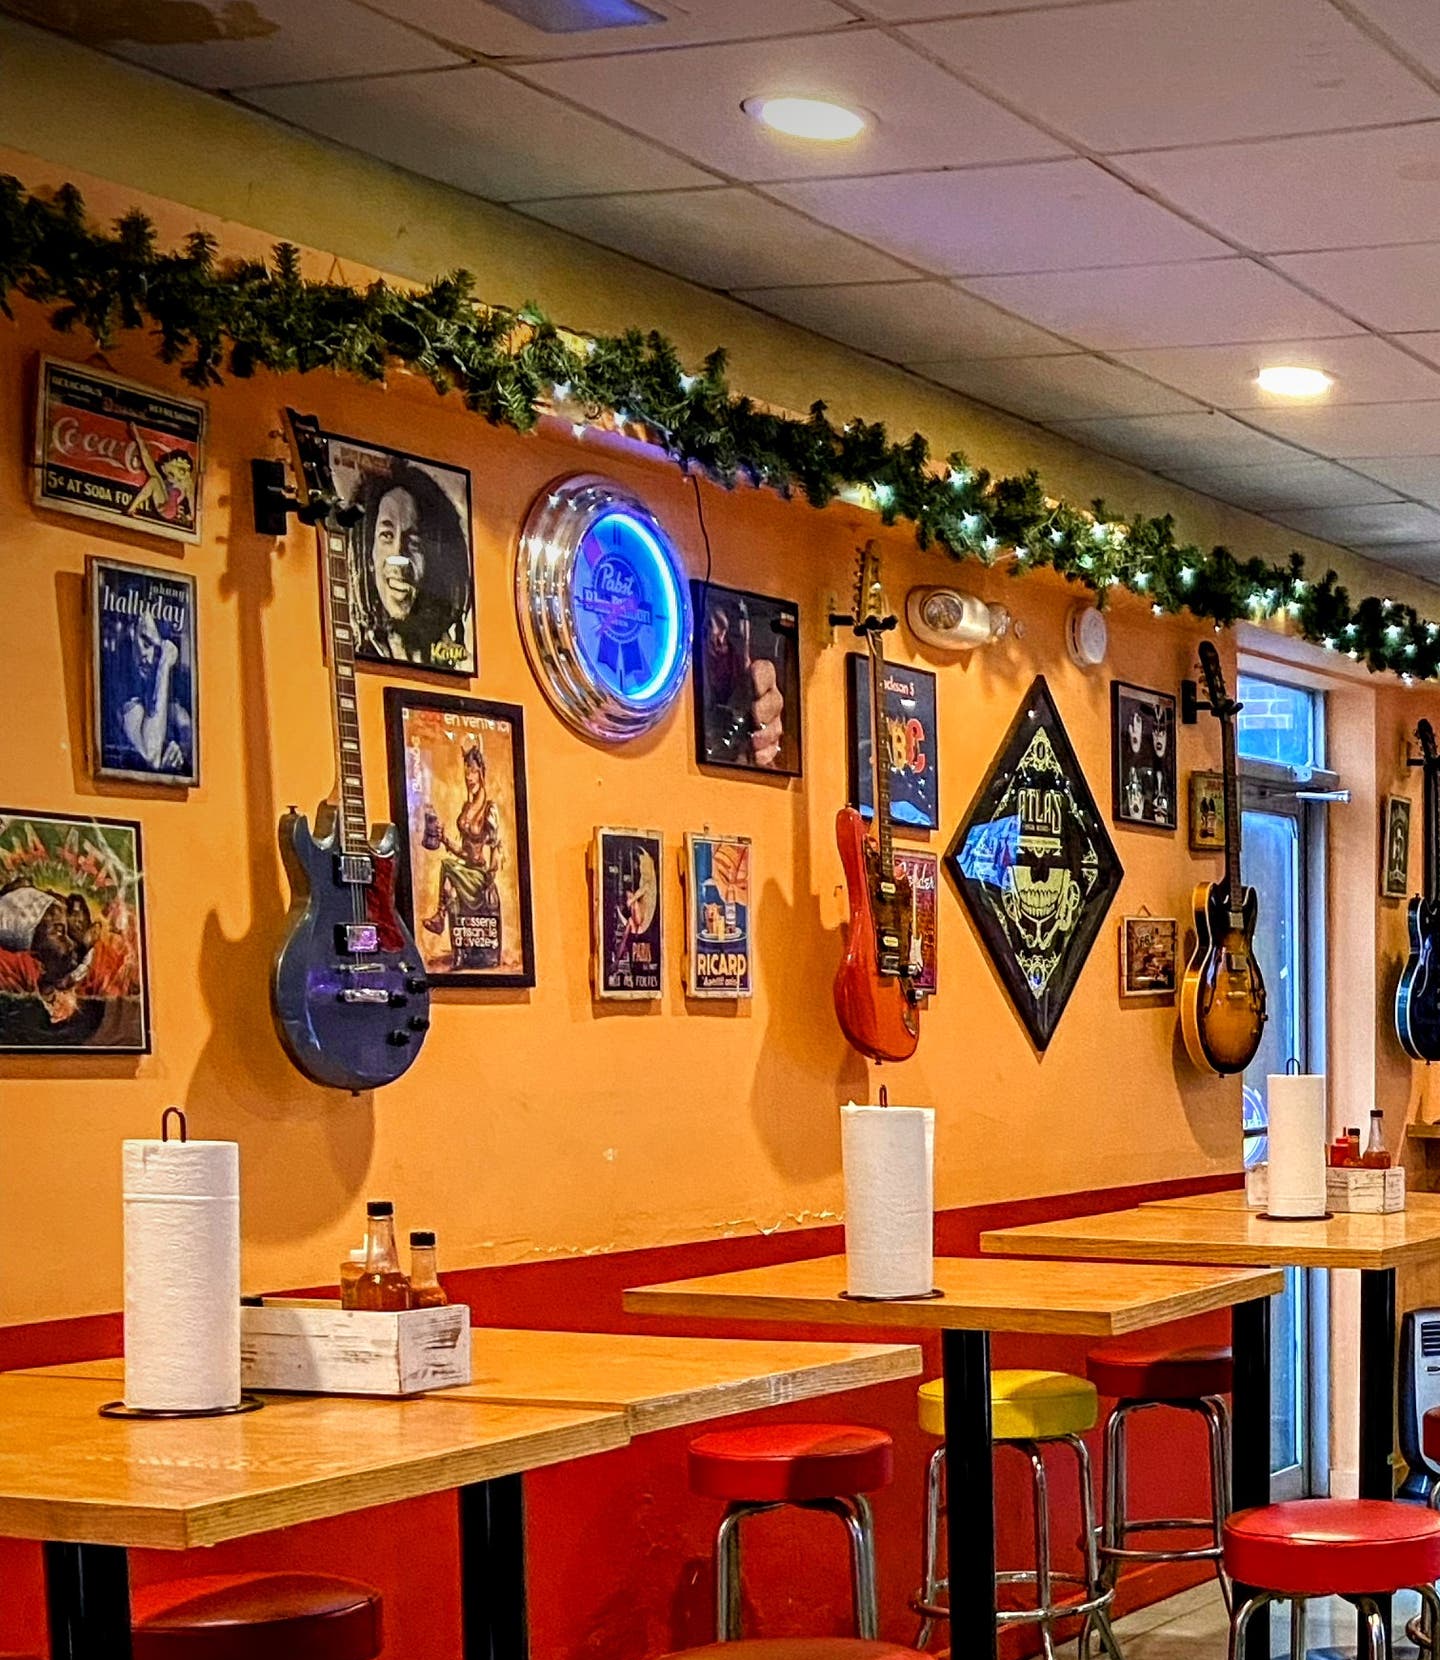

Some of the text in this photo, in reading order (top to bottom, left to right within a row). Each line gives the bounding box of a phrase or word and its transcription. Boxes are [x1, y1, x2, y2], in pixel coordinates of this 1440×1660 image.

[66, 478, 81, 494] AT
[83, 482, 112, 502] SODA
[600, 562, 634, 596] Pabst
[103, 585, 185, 632] hallyday
[430, 641, 469, 662] Kaya
[883, 675, 915, 697] ckson 5
[444, 713, 460, 726] en
[1018, 787, 1062, 834] ATLAS
[697, 953, 746, 976] RICARD
